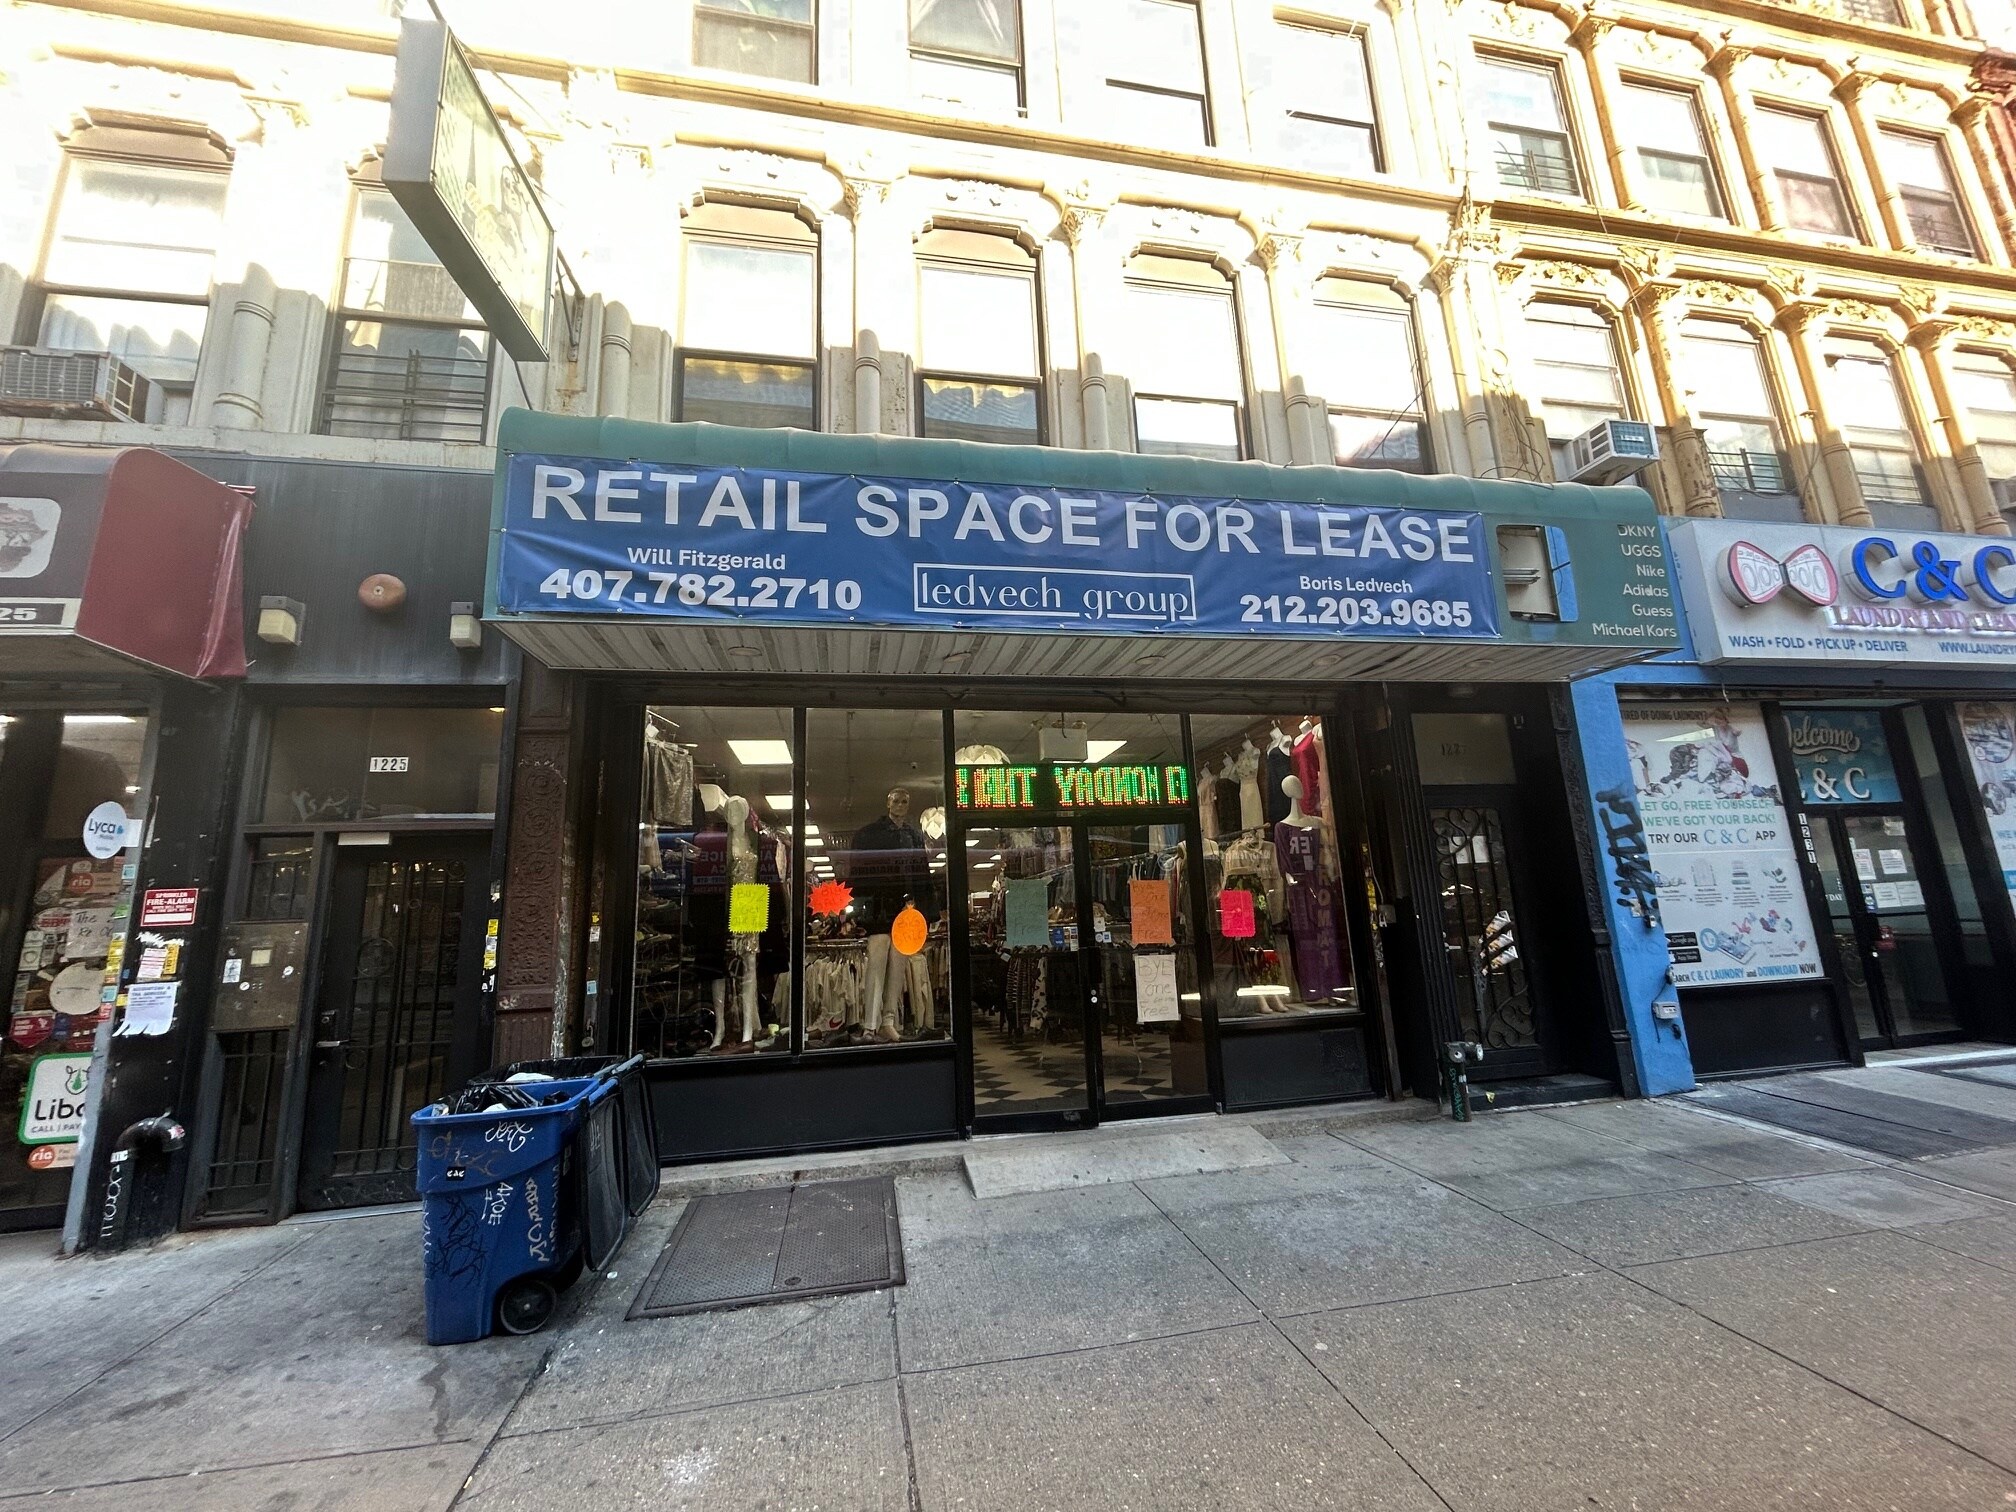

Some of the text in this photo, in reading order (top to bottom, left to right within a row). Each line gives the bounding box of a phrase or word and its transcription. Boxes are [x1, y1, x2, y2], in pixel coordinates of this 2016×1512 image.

[531, 464, 1475, 563] RETAIL SPACE FOR LEASE
[1616, 523, 1657, 539] DKNY
[627, 546, 787, 571] Will Fitzgerald
[1620, 543, 1662, 559] UGGS
[1636, 562, 1666, 578] Nike
[1852, 536, 2016, 605] C & C
[539, 567, 863, 612] 407.782.2710
[1299, 575, 1414, 595] Boris Ledvech
[1622, 582, 1670, 599] Adidas
[921, 573, 1189, 621] ledvech group
[1239, 594, 1473, 629] 212.203.9685
[1631, 602, 1674, 619] Guess
[1833, 605, 1926, 628] LAUNDRY
[1591, 622, 1677, 640] Michael Kors
[1728, 635, 1909, 653] WASH FOLD PICK UP DELIVER
[372, 757, 407, 772] 1225
[1812, 766, 1870, 799] & C
[1661, 801, 1682, 813] GO,
[1684, 800, 1713, 811] FREE
[88, 818, 116, 834] Lyca
[1643, 815, 1680, 827] WE'VE
[1683, 815, 1707, 826] GOT
[1707, 813, 1741, 825] YOUR
[1648, 828, 1777, 845] TRY OUR C & C APP
[146, 897, 195, 906] FIRE-ALARM
[1710, 967, 1745, 980] LAUNDRY
[1758, 964, 1799, 976] DOWNLOAD
[1799, 963, 1817, 974] NOW
[32, 1148, 53, 1161] ria
